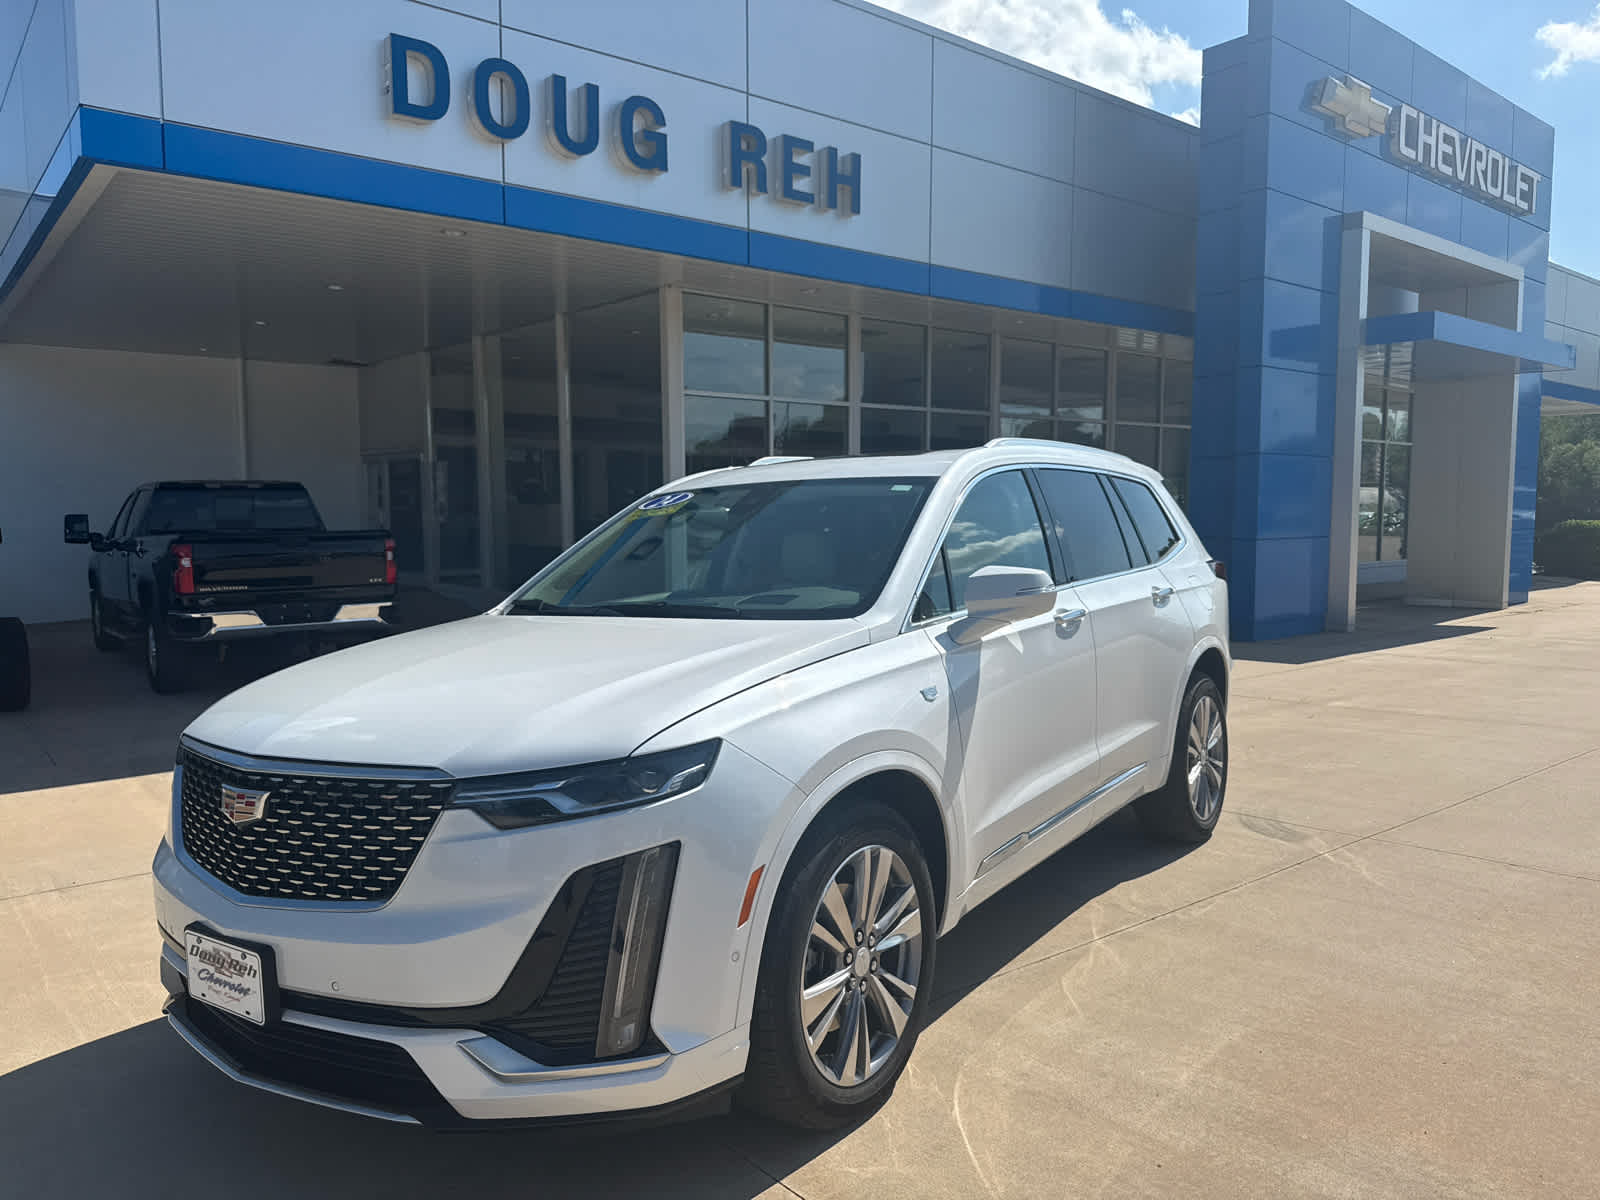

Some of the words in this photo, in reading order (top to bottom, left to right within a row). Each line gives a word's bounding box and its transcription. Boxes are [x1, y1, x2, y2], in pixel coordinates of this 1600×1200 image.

[386, 32, 669, 174] DOUG
[724, 120, 862, 216] REH
[1399, 103, 1541, 214] CHEVROLET
[189, 944, 226, 969] Doug
[229, 957, 258, 979] Reh
[197, 968, 251, 997] Chevrolet
